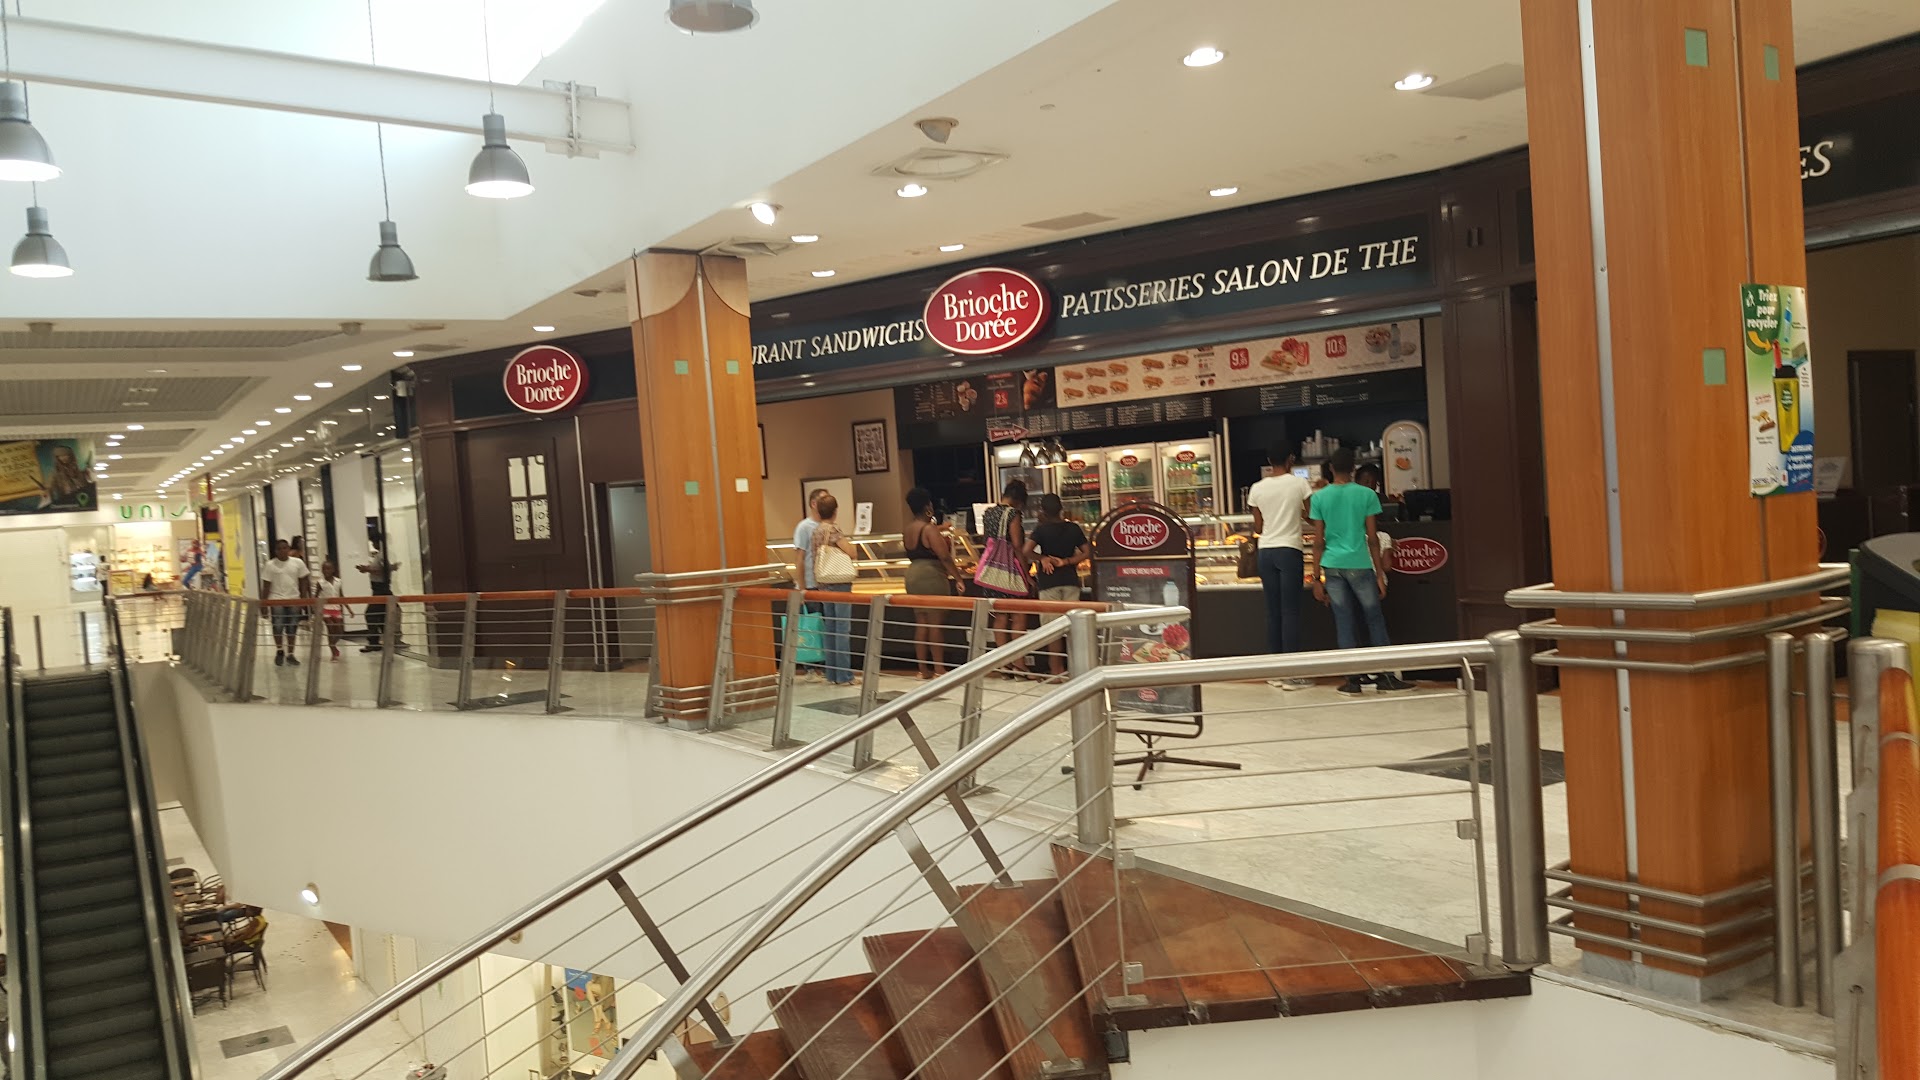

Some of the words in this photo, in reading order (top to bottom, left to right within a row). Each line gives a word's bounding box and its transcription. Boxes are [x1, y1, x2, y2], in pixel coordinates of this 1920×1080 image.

[1061, 272, 1205, 318] PATISSERIES
[1211, 256, 1303, 295] SALON
[1310, 248, 1350, 280] DE
[1358, 236, 1419, 271] THE
[943, 283, 1029, 321] Brioche
[1758, 288, 1778, 302] Triez
[1757, 305, 1775, 318] pour
[955, 313, 1017, 343] Dorée
[1747, 316, 1778, 331] recycler
[811, 318, 925, 357] SANDWICHS
[515, 358, 571, 385] Brioche
[524, 385, 565, 403] Dorée
[1119, 518, 1162, 535] Brioche
[1125, 534, 1156, 546] Dorée
